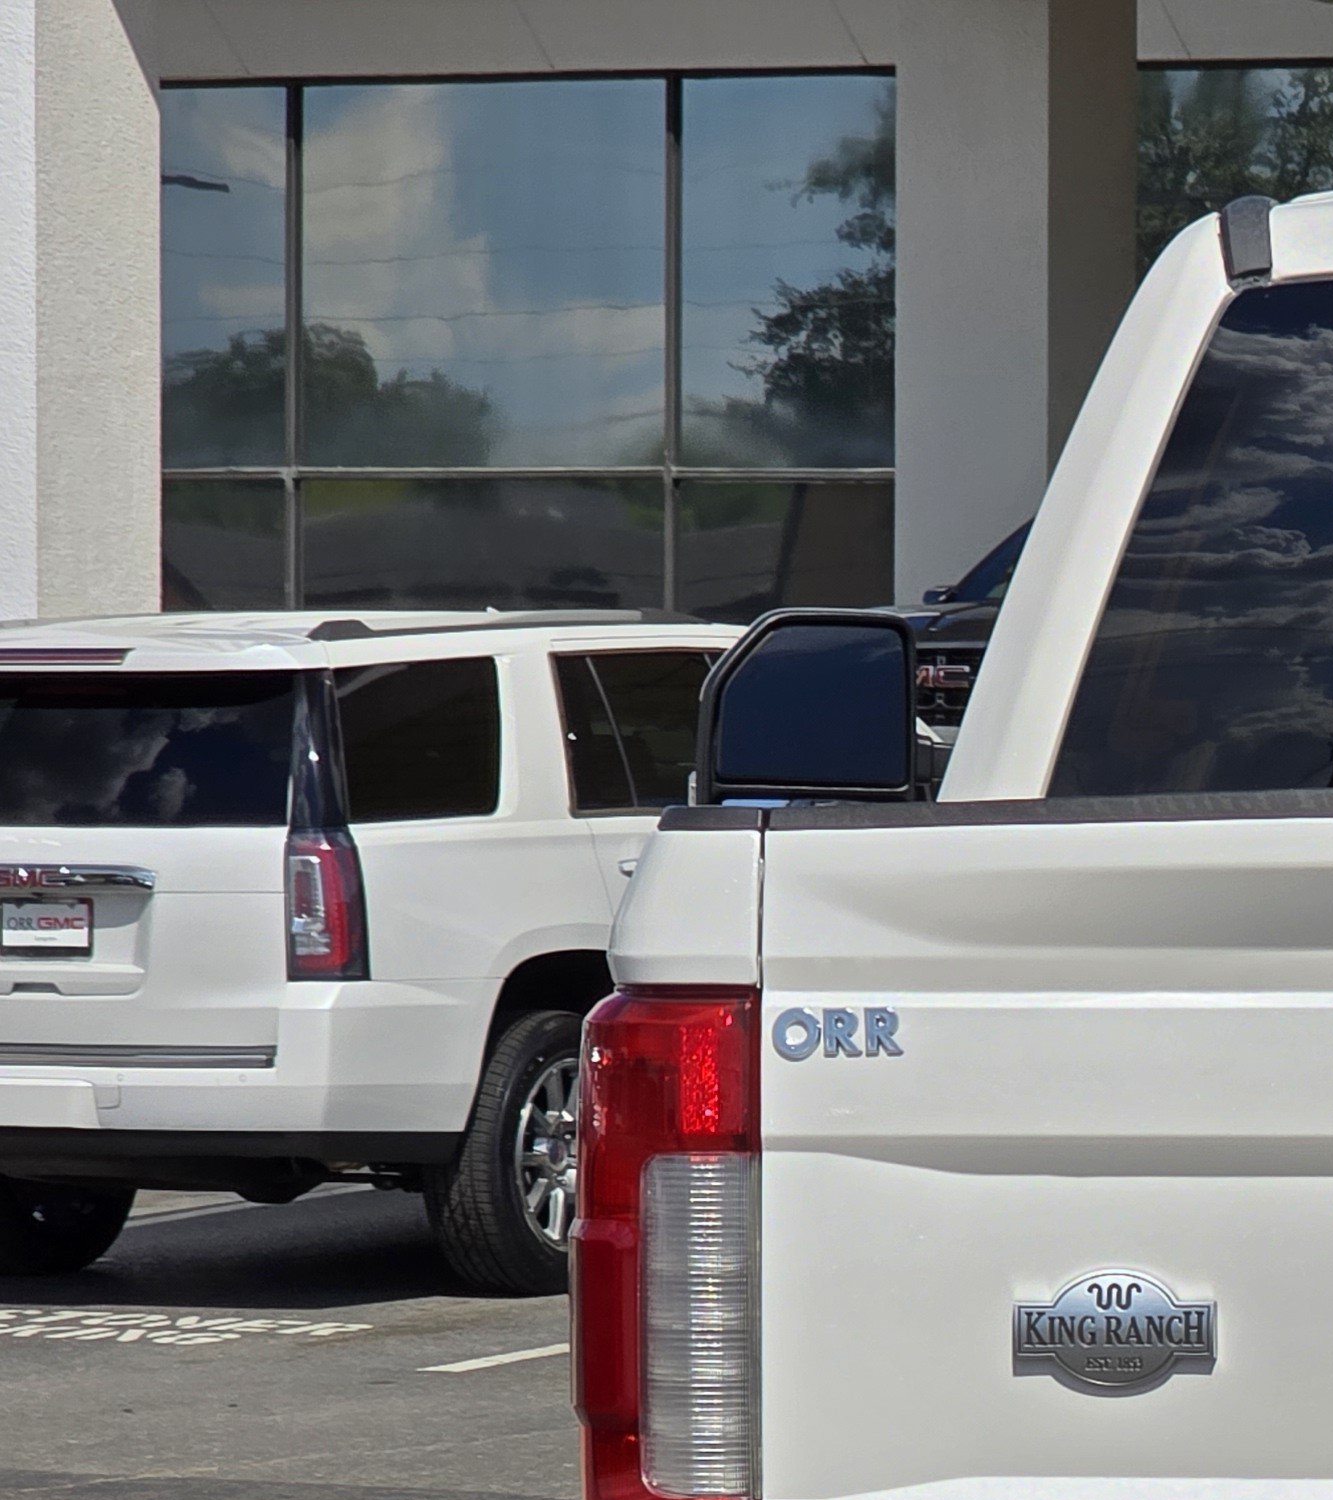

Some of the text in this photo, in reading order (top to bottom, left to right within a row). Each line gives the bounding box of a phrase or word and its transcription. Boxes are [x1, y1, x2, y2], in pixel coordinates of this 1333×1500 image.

[7, 916, 85, 930] ORR GMC
[771, 1006, 905, 1063] ORR
[0, 1324, 243, 1346] KING
[1023, 1310, 1206, 1347] KING RANCH
